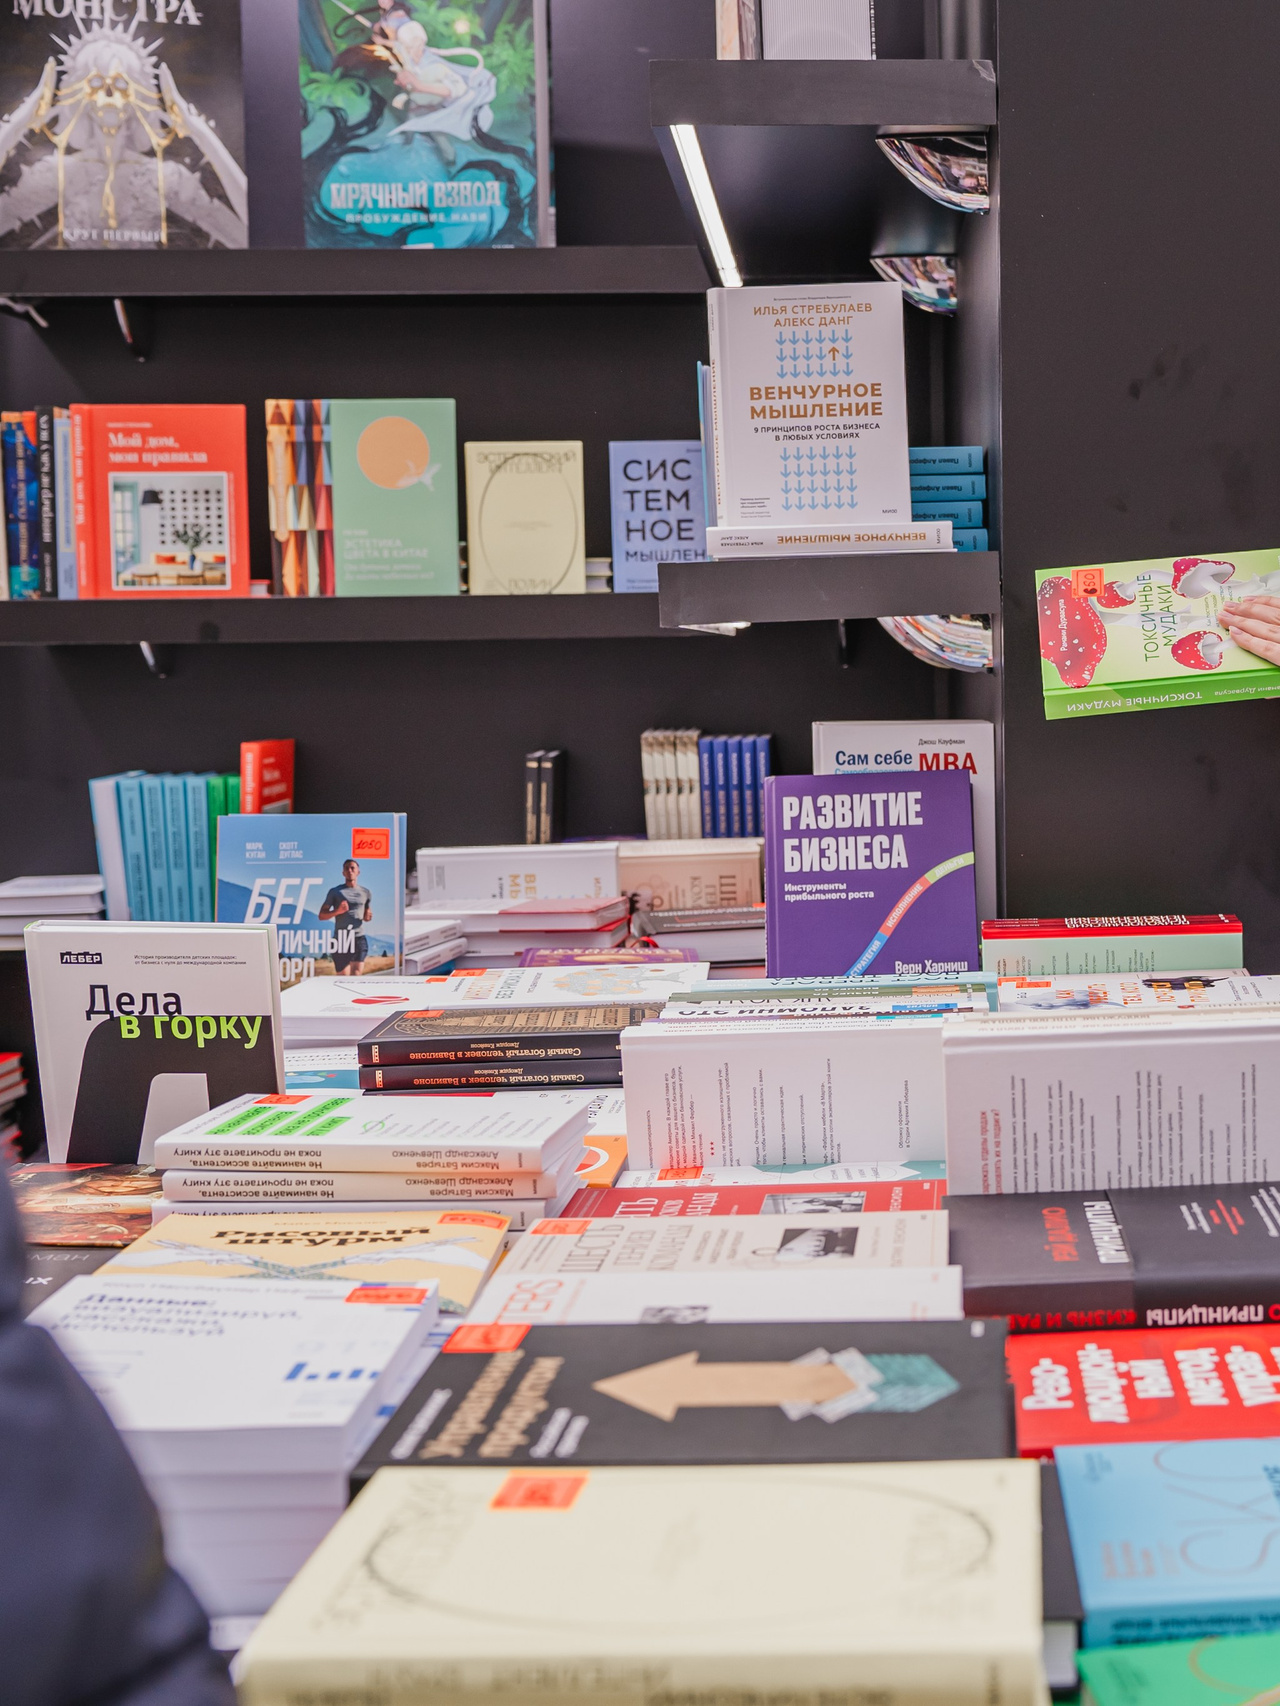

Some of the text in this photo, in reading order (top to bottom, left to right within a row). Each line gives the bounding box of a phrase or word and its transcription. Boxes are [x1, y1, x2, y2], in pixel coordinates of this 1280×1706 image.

[330, 180, 501, 209] МРАЧНЫЙ ВЗВОД
[753, 302, 873, 316] ИЛЬЯ СТРЕБУЛАЕВ
[773, 315, 854, 328] АЛЕКС ДАНГ
[750, 382, 883, 401] ВЕНЧУРНОЕ
[750, 402, 883, 420] МЫШЛЕНИЕ
[761, 425, 812, 433] ПРИНЦИПОВ
[843, 423, 881, 431] БИЗНЕСА
[816, 432, 860, 441] УСЛОВИЯХ
[622, 459, 692, 482] СИС
[622, 489, 690, 512] ТЕМ
[625, 519, 695, 542] НОЕ
[344, 539, 402, 549] ЭСТЕТИКА
[777, 532, 926, 545] ВЕНЧУРНОЕ МЫШЛЕНИЕ
[1136, 574, 1159, 662] ТОКСИЧНЫЕ
[1156, 584, 1174, 647] МУДАКИ
[1057, 598, 1069, 652] Рамани Дурвасула
[1067, 691, 1203, 712] ТОКСИЧНЫЕ МУДАКИ
[918, 738, 937, 746] Джош
[835, 750, 978, 775] Сам себе MBA
[782, 791, 923, 831] РАЗВИТИЕ
[356, 840, 383, 850] 1050
[783, 834, 909, 873] БИЗНЕСА
[784, 882, 847, 892] Инструменты
[243, 877, 324, 925] БЕГ
[784, 891, 875, 902] прибыльного роста
[886, 883, 924, 928] ИСПОЛНЕНИЕ
[278, 924, 356, 954] ЛИЧНЫЙ
[61, 954, 101, 963] ЛЕБЕР
[279, 957, 315, 982] ОРД
[894, 959, 969, 974] Верн Харниш
[85, 984, 183, 1021] Дела
[119, 1015, 263, 1049] в горку
[409, 1051, 456, 1060] Вавилоне
[464, 1050, 504, 1059] человек
[505, 1048, 546, 1057] богатый
[547, 1047, 582, 1057] Самый
[413, 1077, 460, 1086] Вавилоне
[468, 1076, 508, 1084] человек
[509, 1074, 549, 1083] богатый
[550, 1073, 585, 1083] Самый
[173, 1149, 202, 1158] книгу
[204, 1148, 221, 1157] эту
[223, 1148, 282, 1158] прочитаете
[298, 1150, 322, 1158] пока
[391, 1150, 499, 1160] Александр Шевченко
[189, 1160, 323, 1169] Не нанимайте ассистента,
[416, 1161, 500, 1170] Максим Батырев
[181, 1178, 212, 1188] книгу
[213, 1178, 231, 1188] эту
[232, 1178, 293, 1188] прочитаете
[310, 1180, 334, 1188] пока
[405, 1177, 514, 1187] Александр Шевченко
[198, 1190, 335, 1199] Не нанимайте ассистента,
[429, 1188, 514, 1197] Максим Батырев
[210, 1226, 431, 1239] Рисовый
[1041, 1207, 1080, 1262] РЭЙ ДАЛИО
[1083, 1200, 1130, 1264] ПРИНЦИПЫ
[224, 1236, 408, 1248] штурм
[1046, 1312, 1062, 1329] И
[1067, 1308, 1137, 1327] ЖИЗНЬ
[1146, 1304, 1264, 1327] ПРИНЦИПЫ
[1128, 1357, 1174, 1400] ный
[1173, 1346, 1230, 1407] метод
[1021, 1357, 1075, 1411] Рево-
